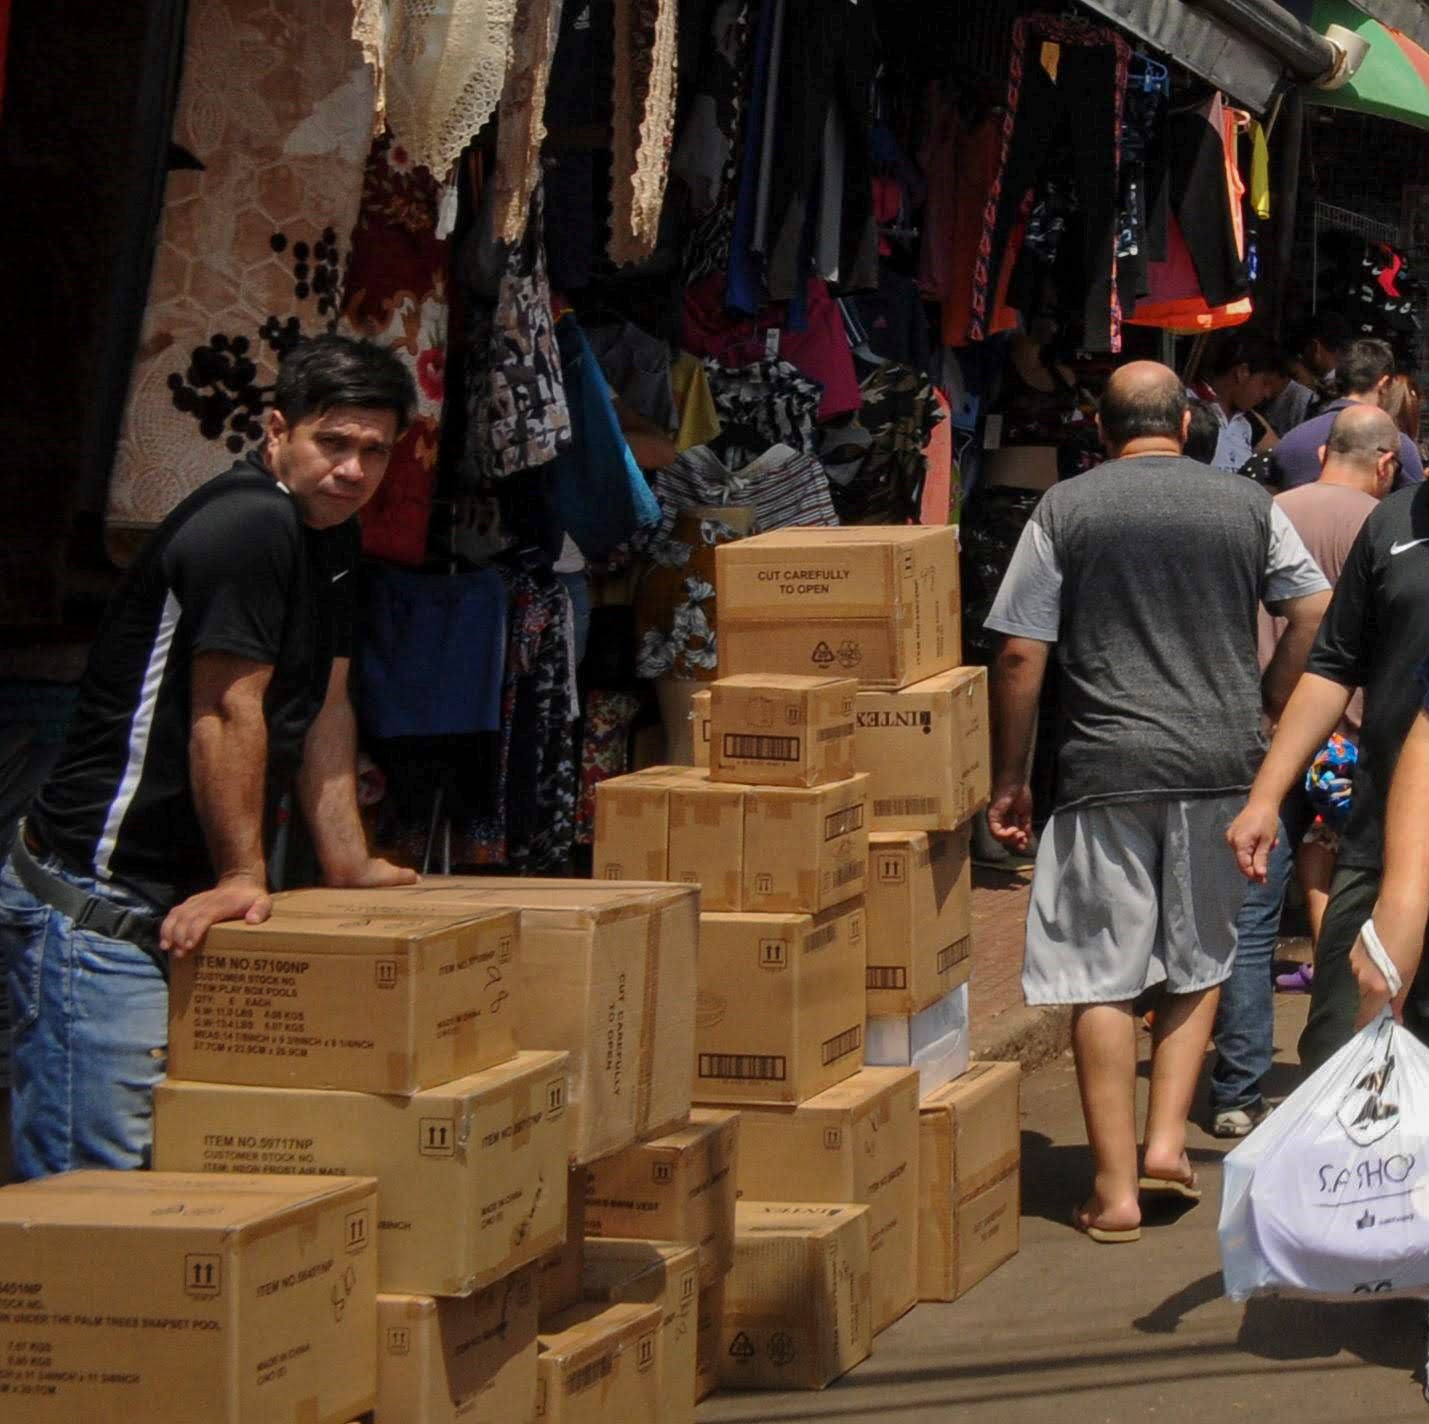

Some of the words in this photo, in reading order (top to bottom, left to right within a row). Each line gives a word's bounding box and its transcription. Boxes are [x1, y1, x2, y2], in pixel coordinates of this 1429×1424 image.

[758, 570, 781, 581] CUT
[784, 570, 850, 581] CAREFULLY
[779, 584, 795, 594] TO
[797, 584, 829, 593] OPEN
[204, 1135, 234, 1147] ITEM
[262, 1152, 295, 1162] STOCK
